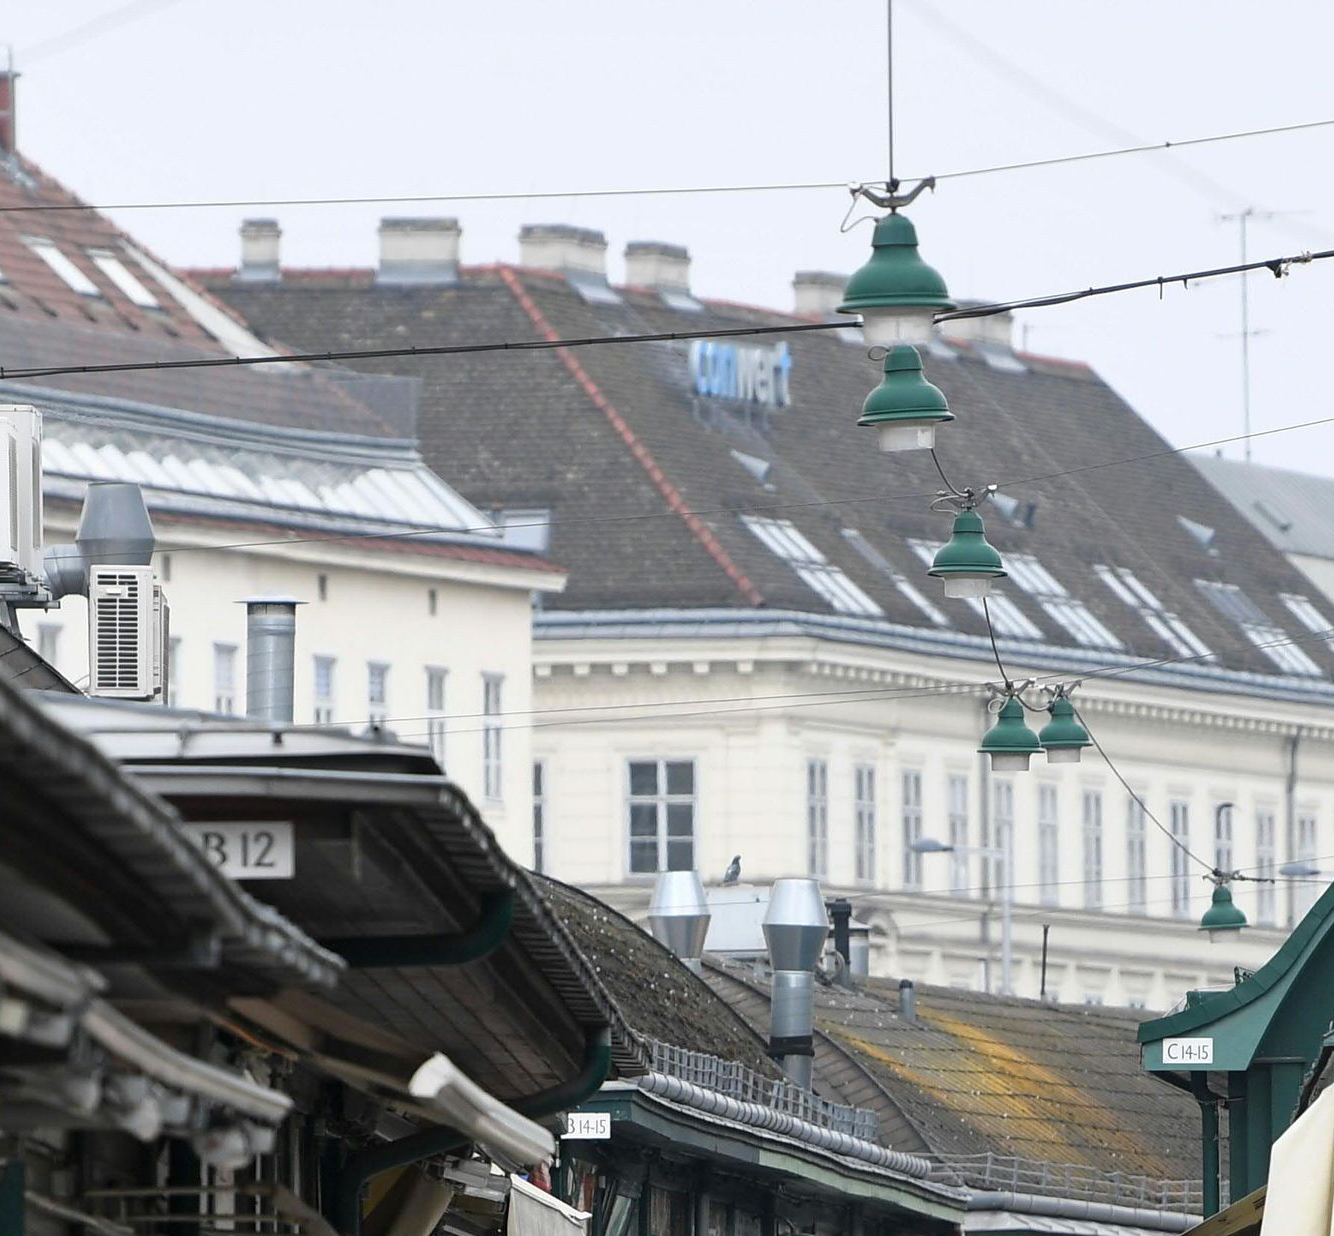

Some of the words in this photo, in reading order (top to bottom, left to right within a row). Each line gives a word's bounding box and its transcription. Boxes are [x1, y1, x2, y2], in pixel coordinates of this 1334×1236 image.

[203, 831, 227, 866] B
[240, 831, 275, 868] 12
[1167, 1043, 1178, 1060] C
[1181, 1044, 1209, 1060] 14-15
[579, 1117, 607, 1134] 14-15
